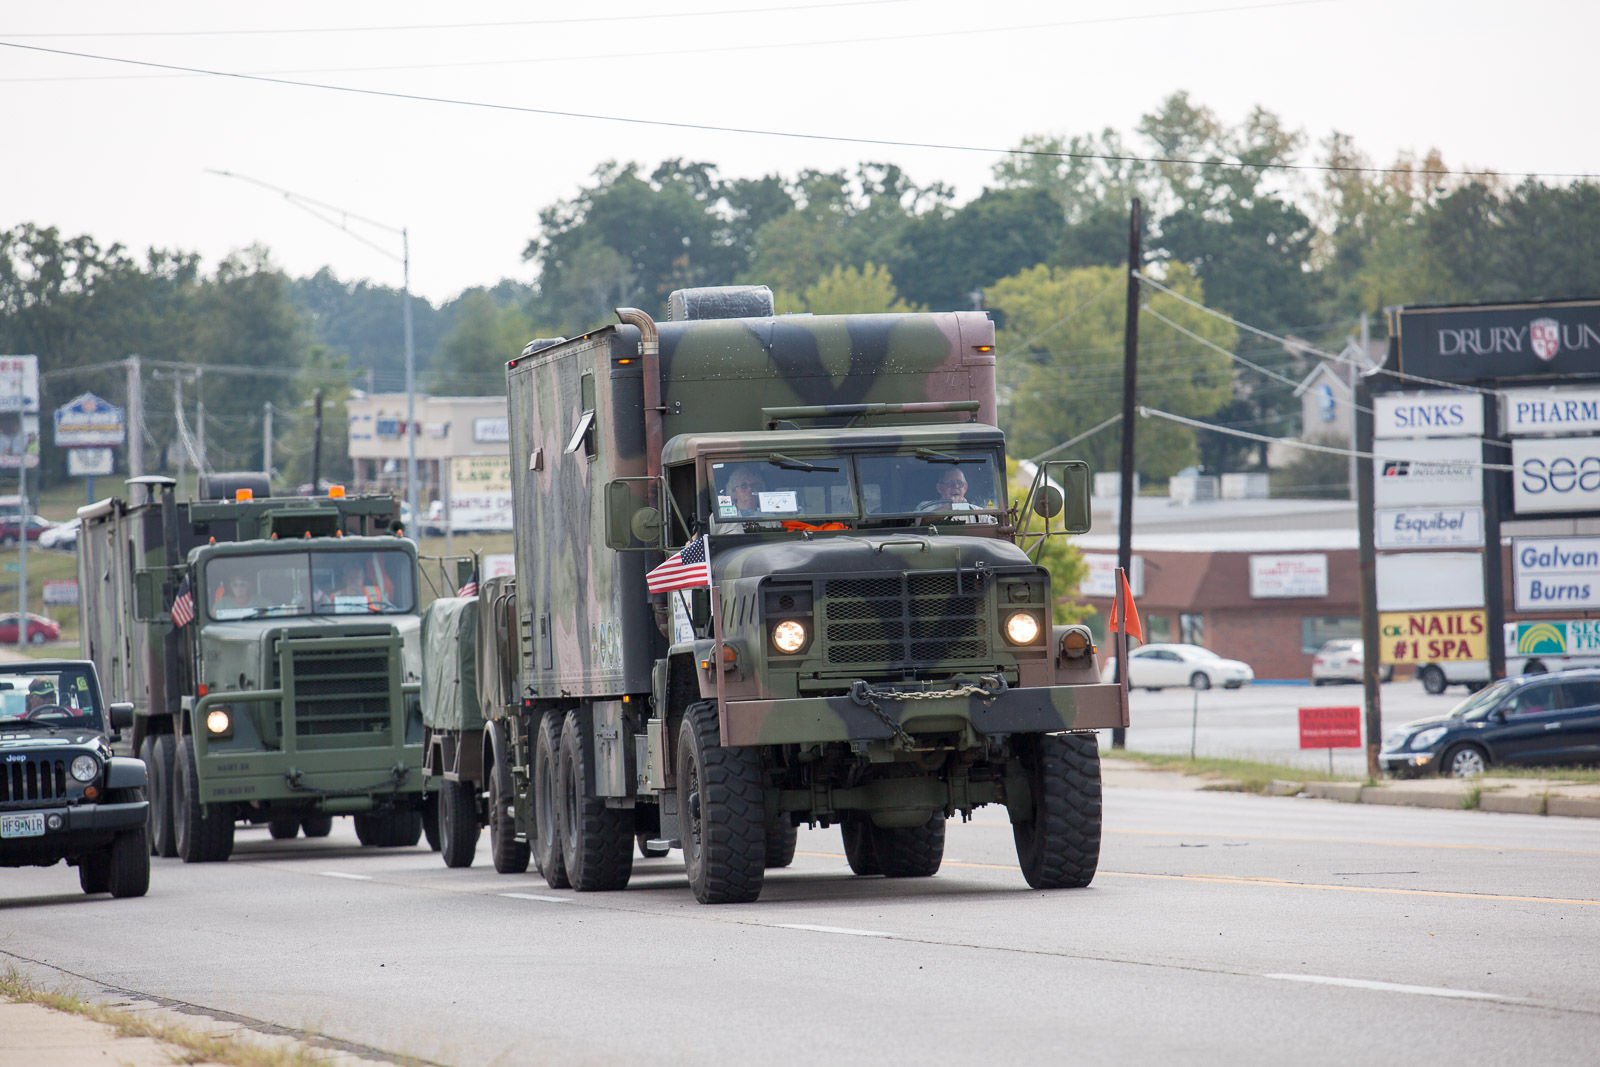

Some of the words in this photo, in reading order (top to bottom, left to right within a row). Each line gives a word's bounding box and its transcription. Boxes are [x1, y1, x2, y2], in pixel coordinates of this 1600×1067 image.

[1438, 326, 1528, 355] DRURY
[1394, 404, 1464, 428] SINKS
[1517, 400, 1598, 423] PHARM
[1394, 512, 1464, 533] Esquibel
[1520, 546, 1599, 569] Galvan
[1530, 580, 1590, 600] Burns
[1409, 615, 1483, 635] NAILS
[1394, 641, 1418, 659] #1
[1428, 639, 1472, 658] SPA
[6, 754, 26, 762] Jeep
